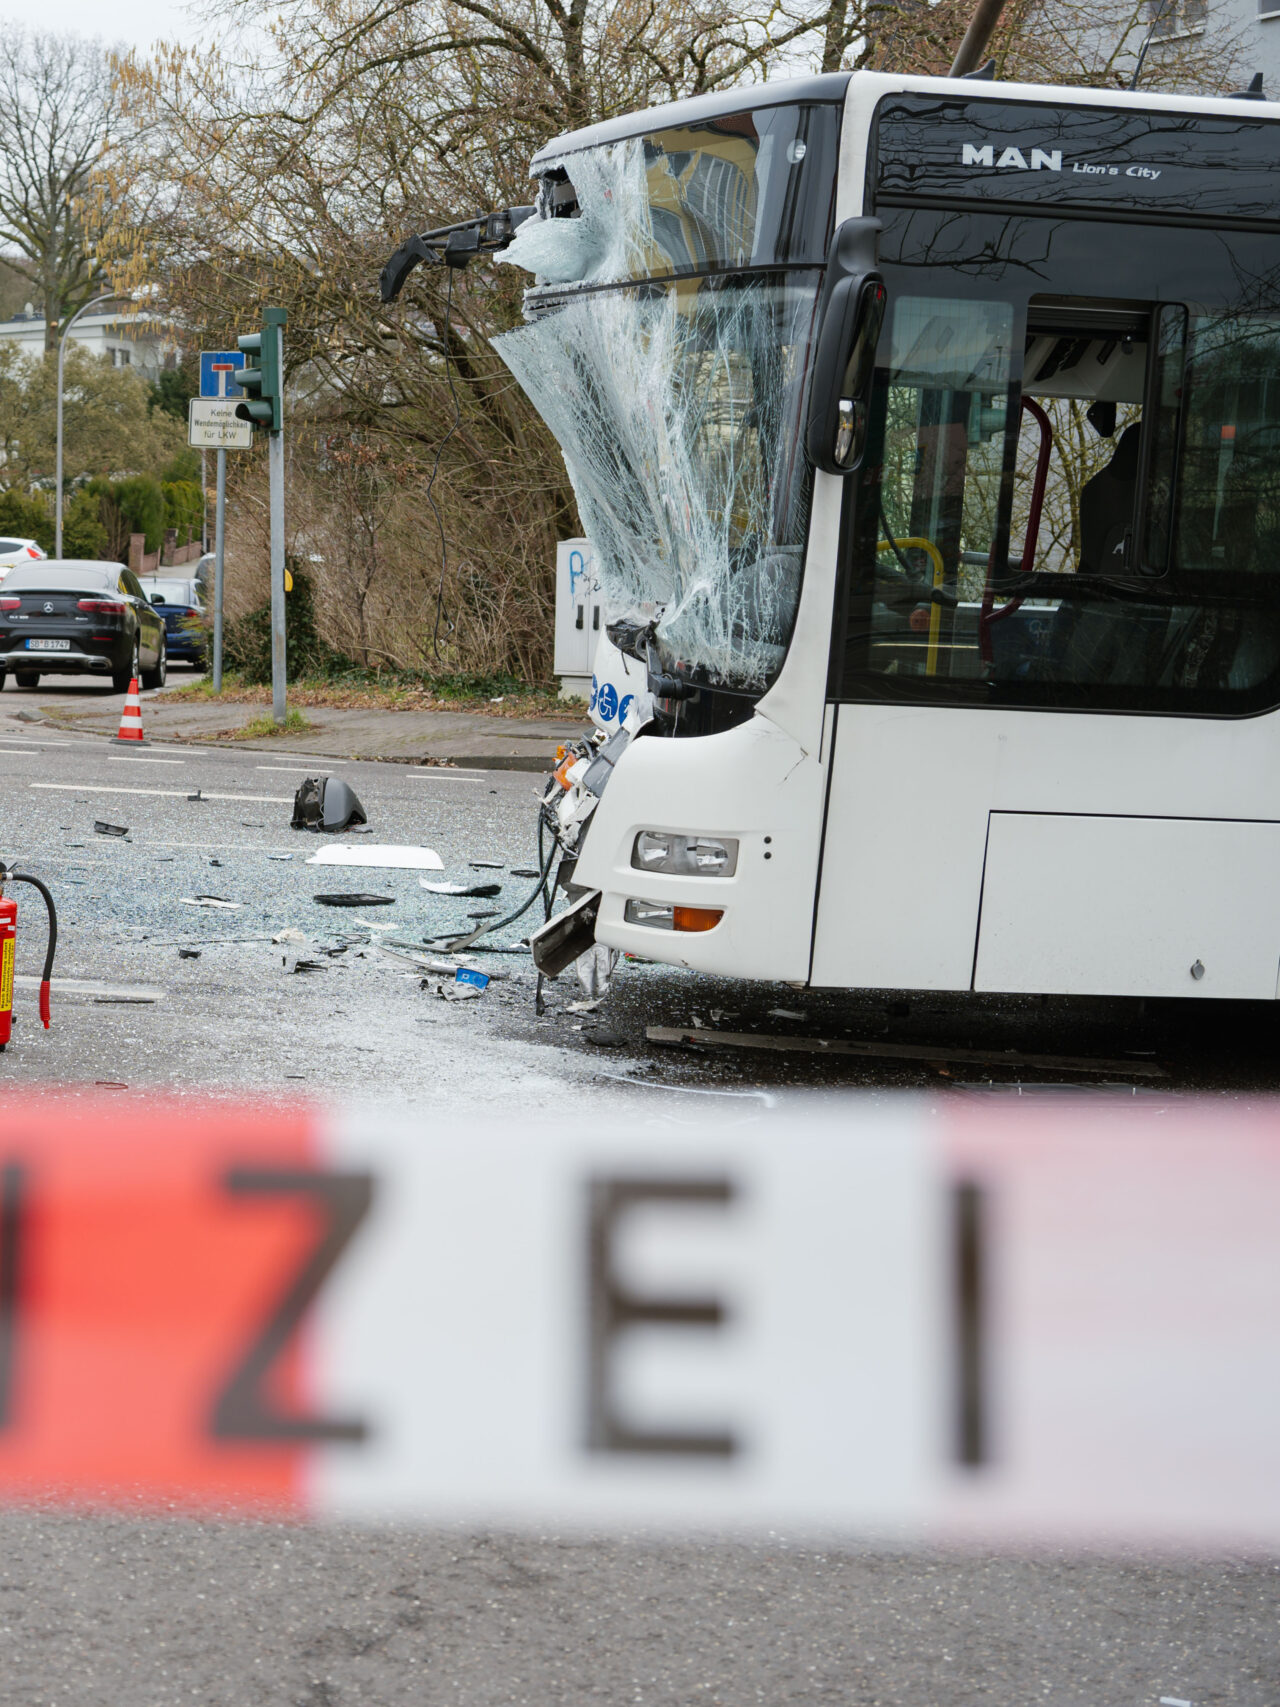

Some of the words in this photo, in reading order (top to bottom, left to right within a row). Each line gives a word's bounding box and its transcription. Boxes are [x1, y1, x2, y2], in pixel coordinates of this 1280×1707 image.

[962, 143, 1062, 171] MAN
[1072, 162, 1119, 175] Lion's
[1126, 165, 1162, 180] City
[211, 409, 232, 417] Keine
[194, 420, 248, 429] Wendemöglichkeit
[204, 431, 215, 439] für
[218, 431, 236, 439] LKW
